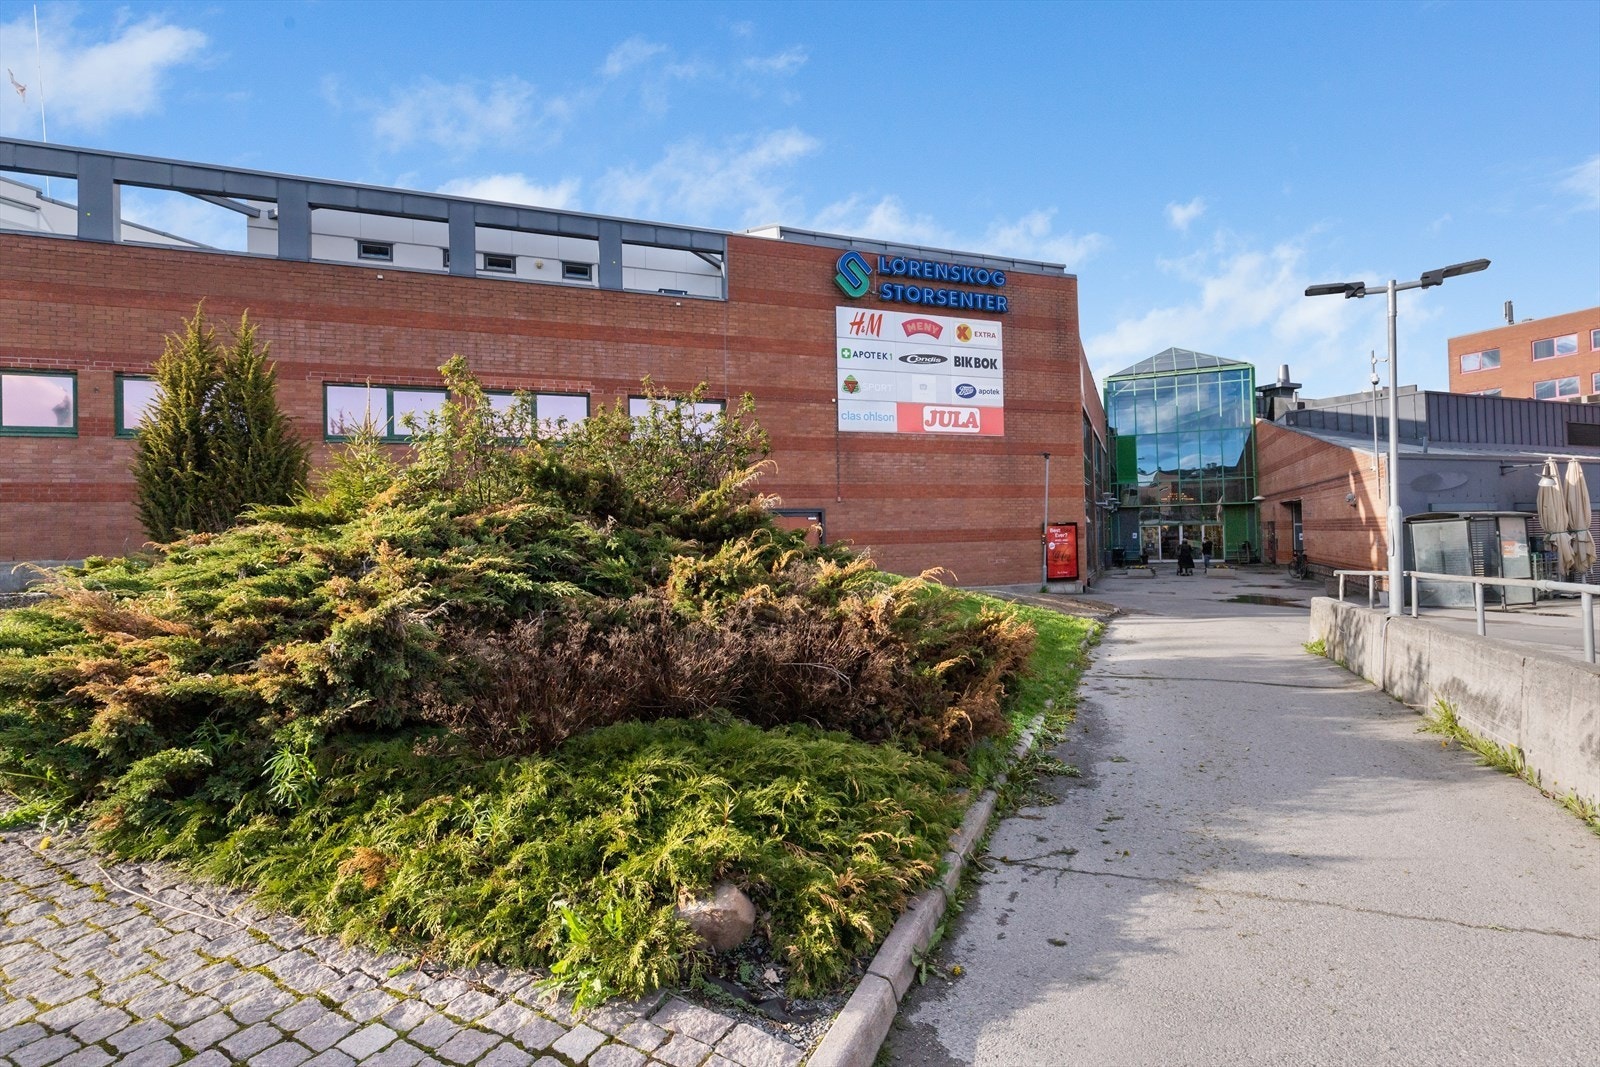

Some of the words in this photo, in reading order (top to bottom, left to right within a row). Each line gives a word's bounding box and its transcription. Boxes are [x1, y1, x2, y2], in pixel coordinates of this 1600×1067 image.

[878, 255, 1007, 287] LØRENSKOG
[880, 283, 1009, 312] STORSENTER
[849, 311, 883, 338] H&M
[906, 321, 940, 334] MENY
[974, 331, 997, 339] EXTRA
[852, 350, 888, 361] APOTEK
[978, 388, 1000, 396] apotek
[841, 410, 861, 422] clas
[863, 411, 895, 423] ohlson
[924, 408, 980, 429] JULA
